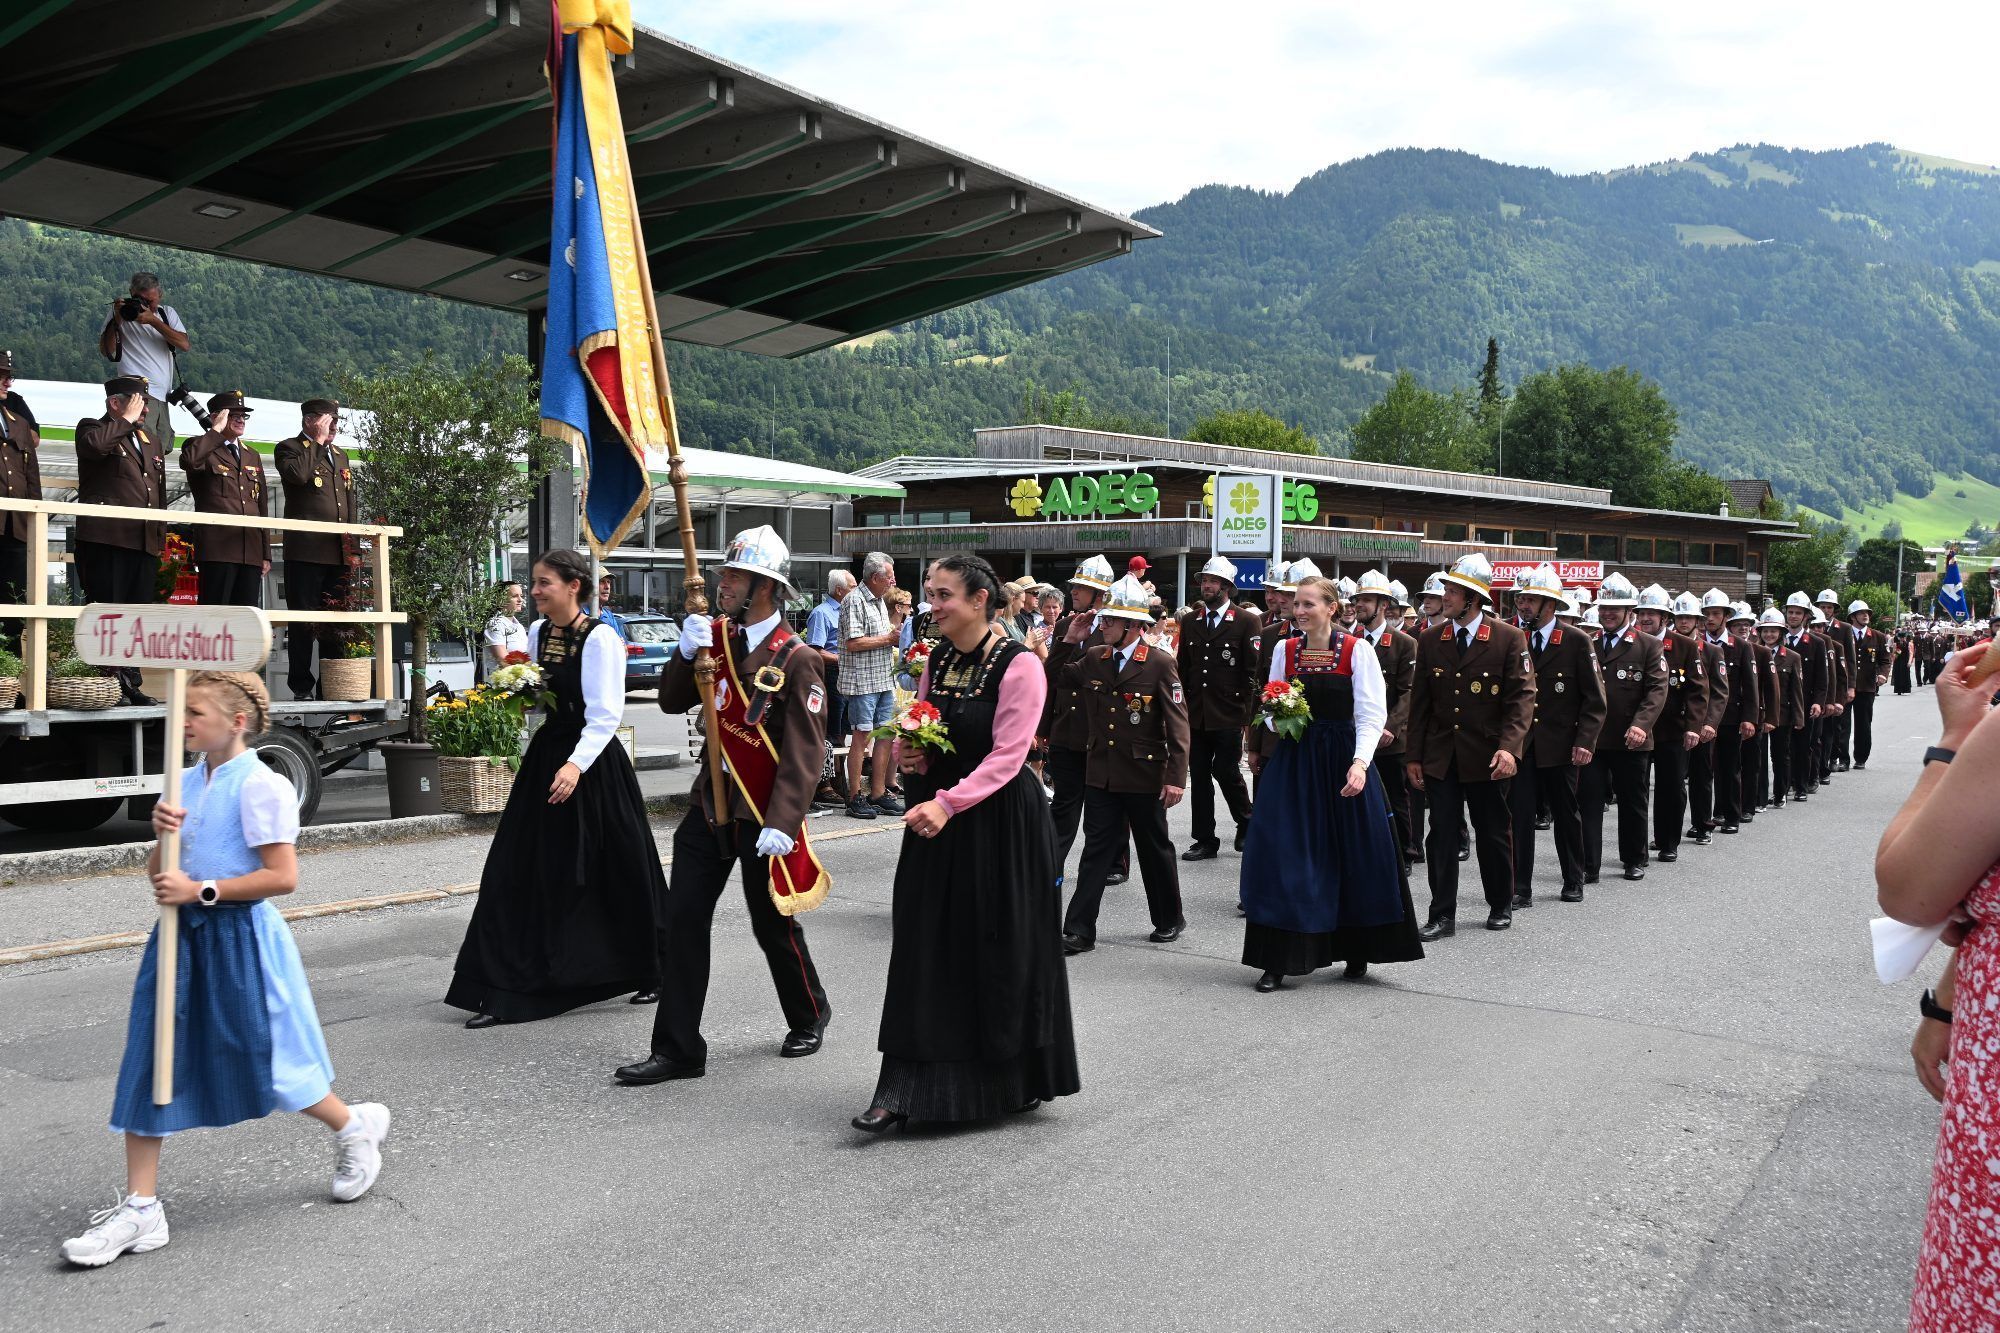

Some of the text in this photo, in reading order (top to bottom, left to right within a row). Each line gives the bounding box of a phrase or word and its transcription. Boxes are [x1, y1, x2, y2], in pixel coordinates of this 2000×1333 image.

[1041, 473, 1158, 516] ADEG
[1282, 480, 1319, 522] EG
[1221, 516, 1267, 531] ADEG
[1341, 537, 1418, 552] HERZLICH WILLKOMMEN
[94, 613, 235, 660] FF Andelsbuch
[720, 716, 763, 748] Andelsbuch
